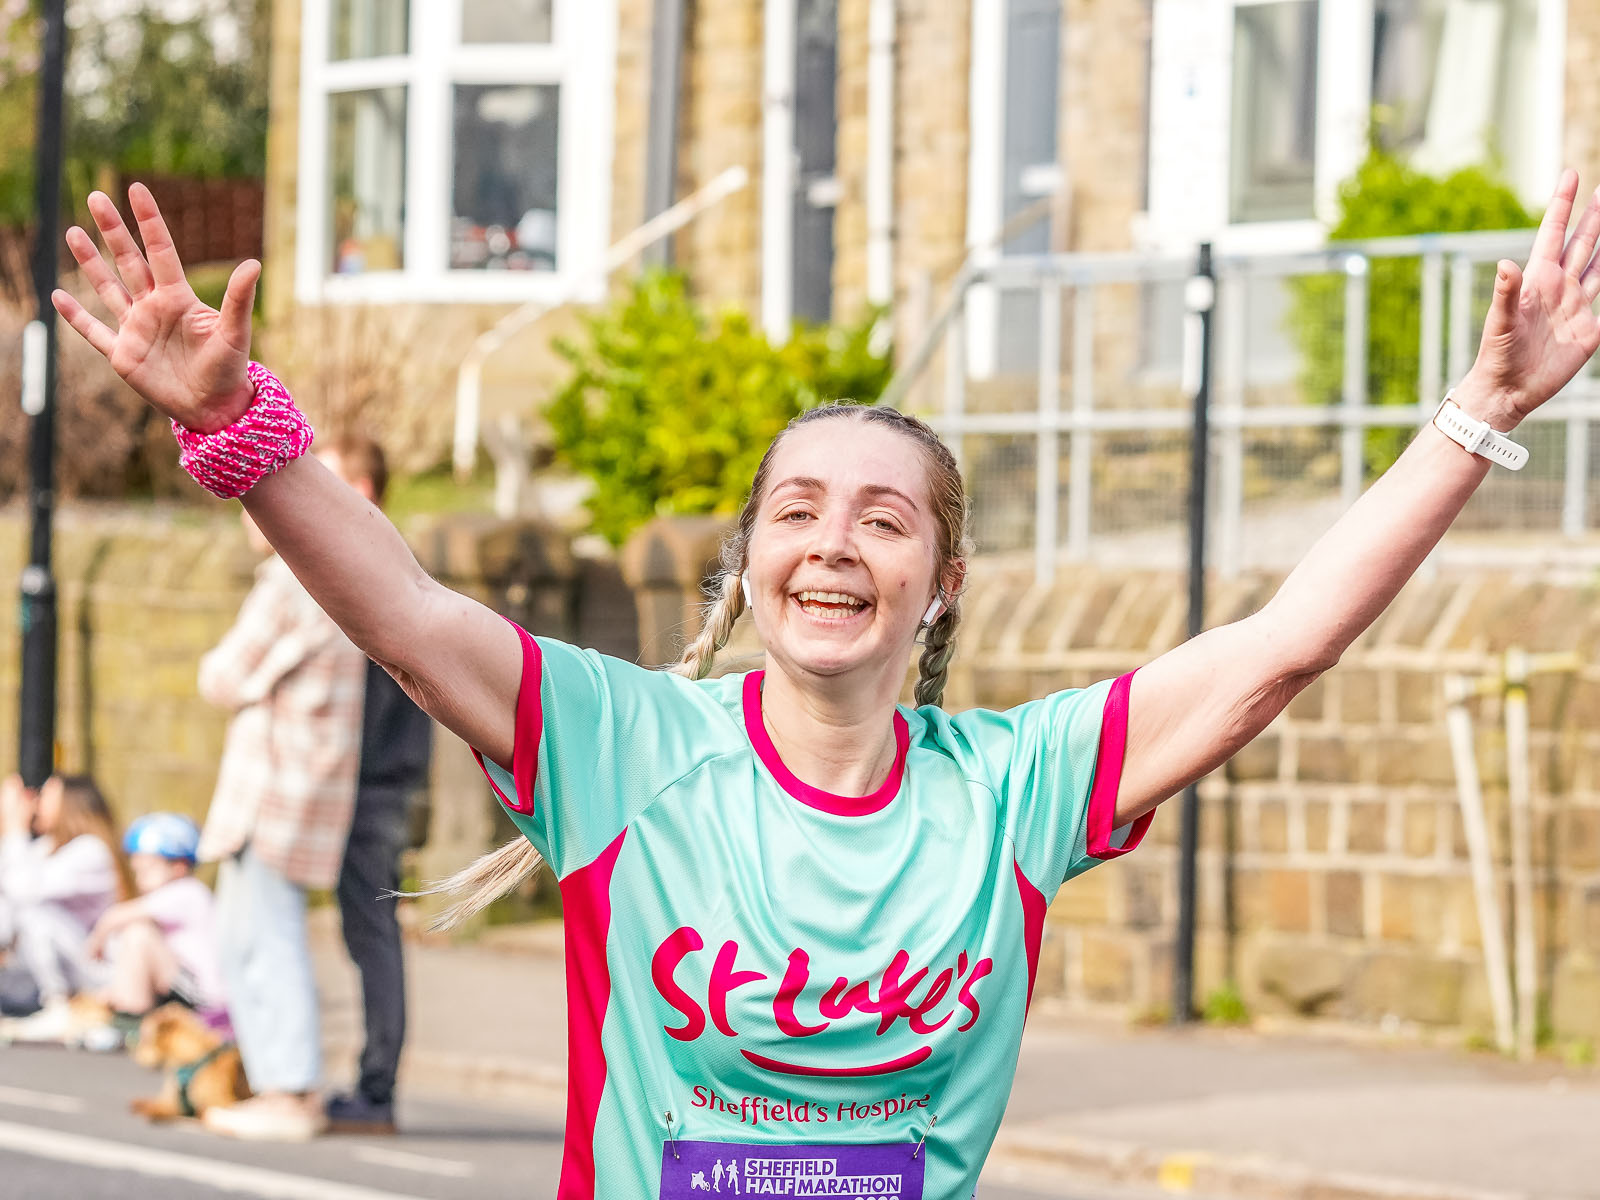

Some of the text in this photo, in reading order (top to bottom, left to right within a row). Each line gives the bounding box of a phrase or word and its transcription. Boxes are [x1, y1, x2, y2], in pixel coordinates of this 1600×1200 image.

[651, 926, 993, 1042] St Luke's
[691, 1085, 828, 1125] Sheffield's
[746, 1159, 835, 1177] SHEFFIELD
[745, 1176, 900, 1195] HALF MARATHON
